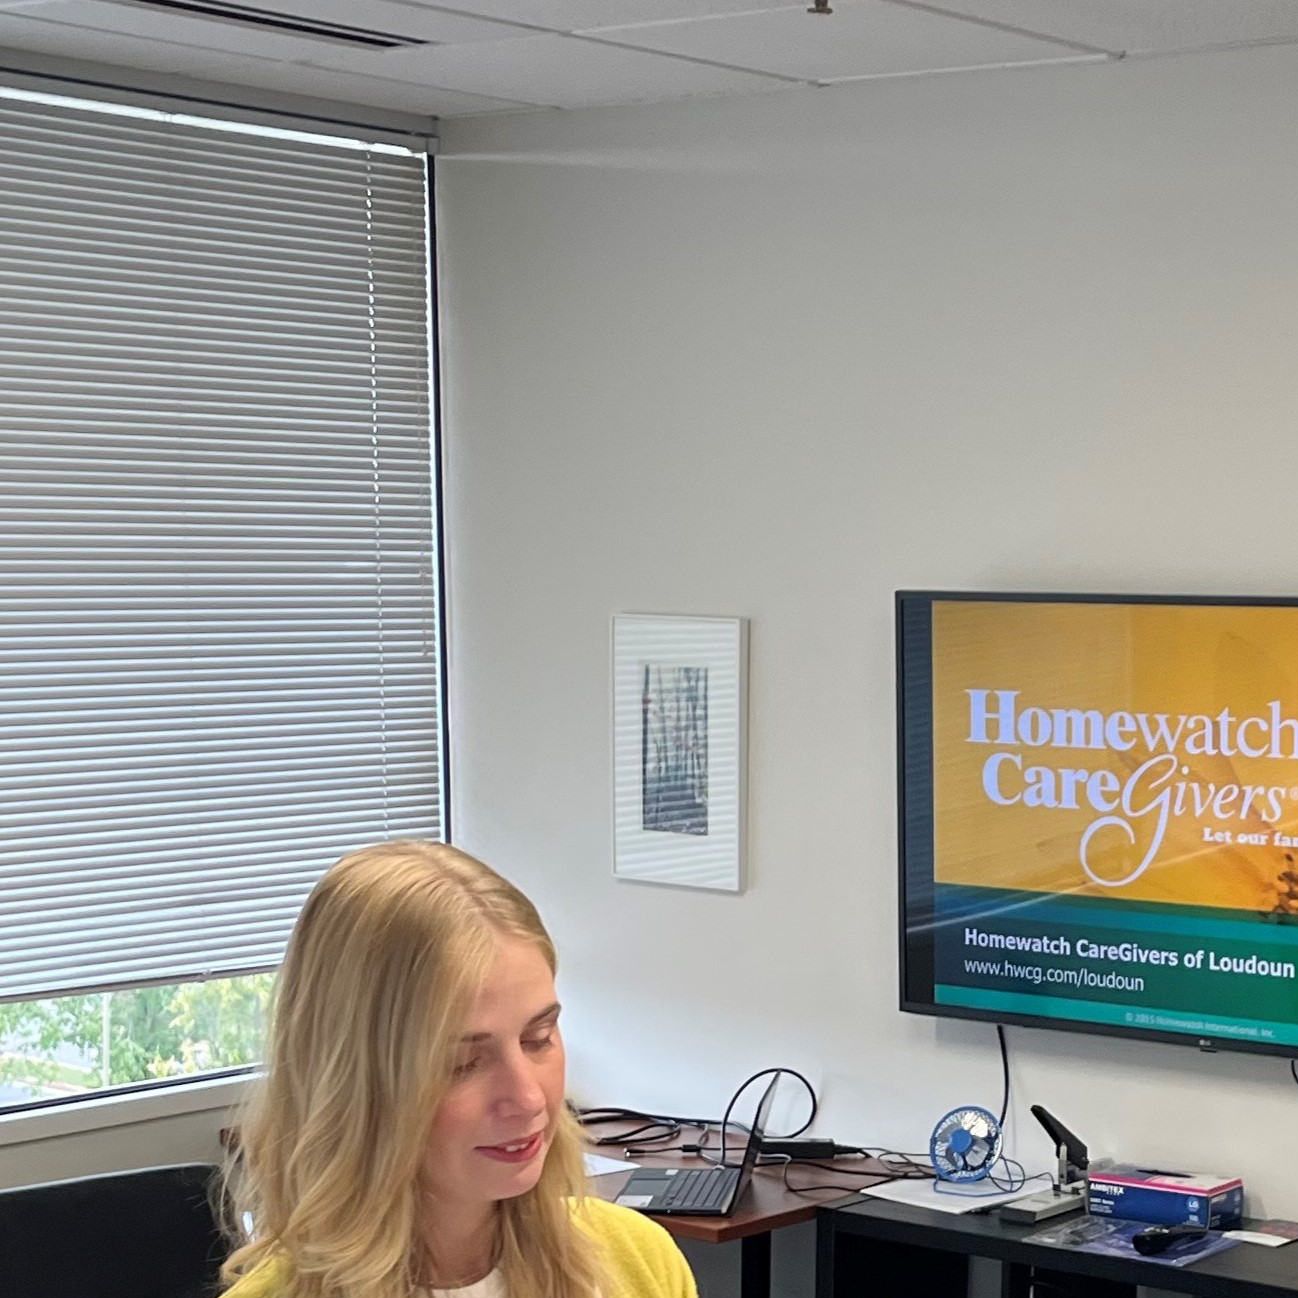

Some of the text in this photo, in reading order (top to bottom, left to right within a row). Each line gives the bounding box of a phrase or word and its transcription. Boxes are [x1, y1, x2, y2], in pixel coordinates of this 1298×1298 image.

[1203, 827, 1232, 843] Let
[1237, 831, 1268, 845] our
[964, 927, 1296, 979] Homewatch CareGivers of Loudoun
[964, 958, 1145, 992] www.hwcg.com/loudoun
